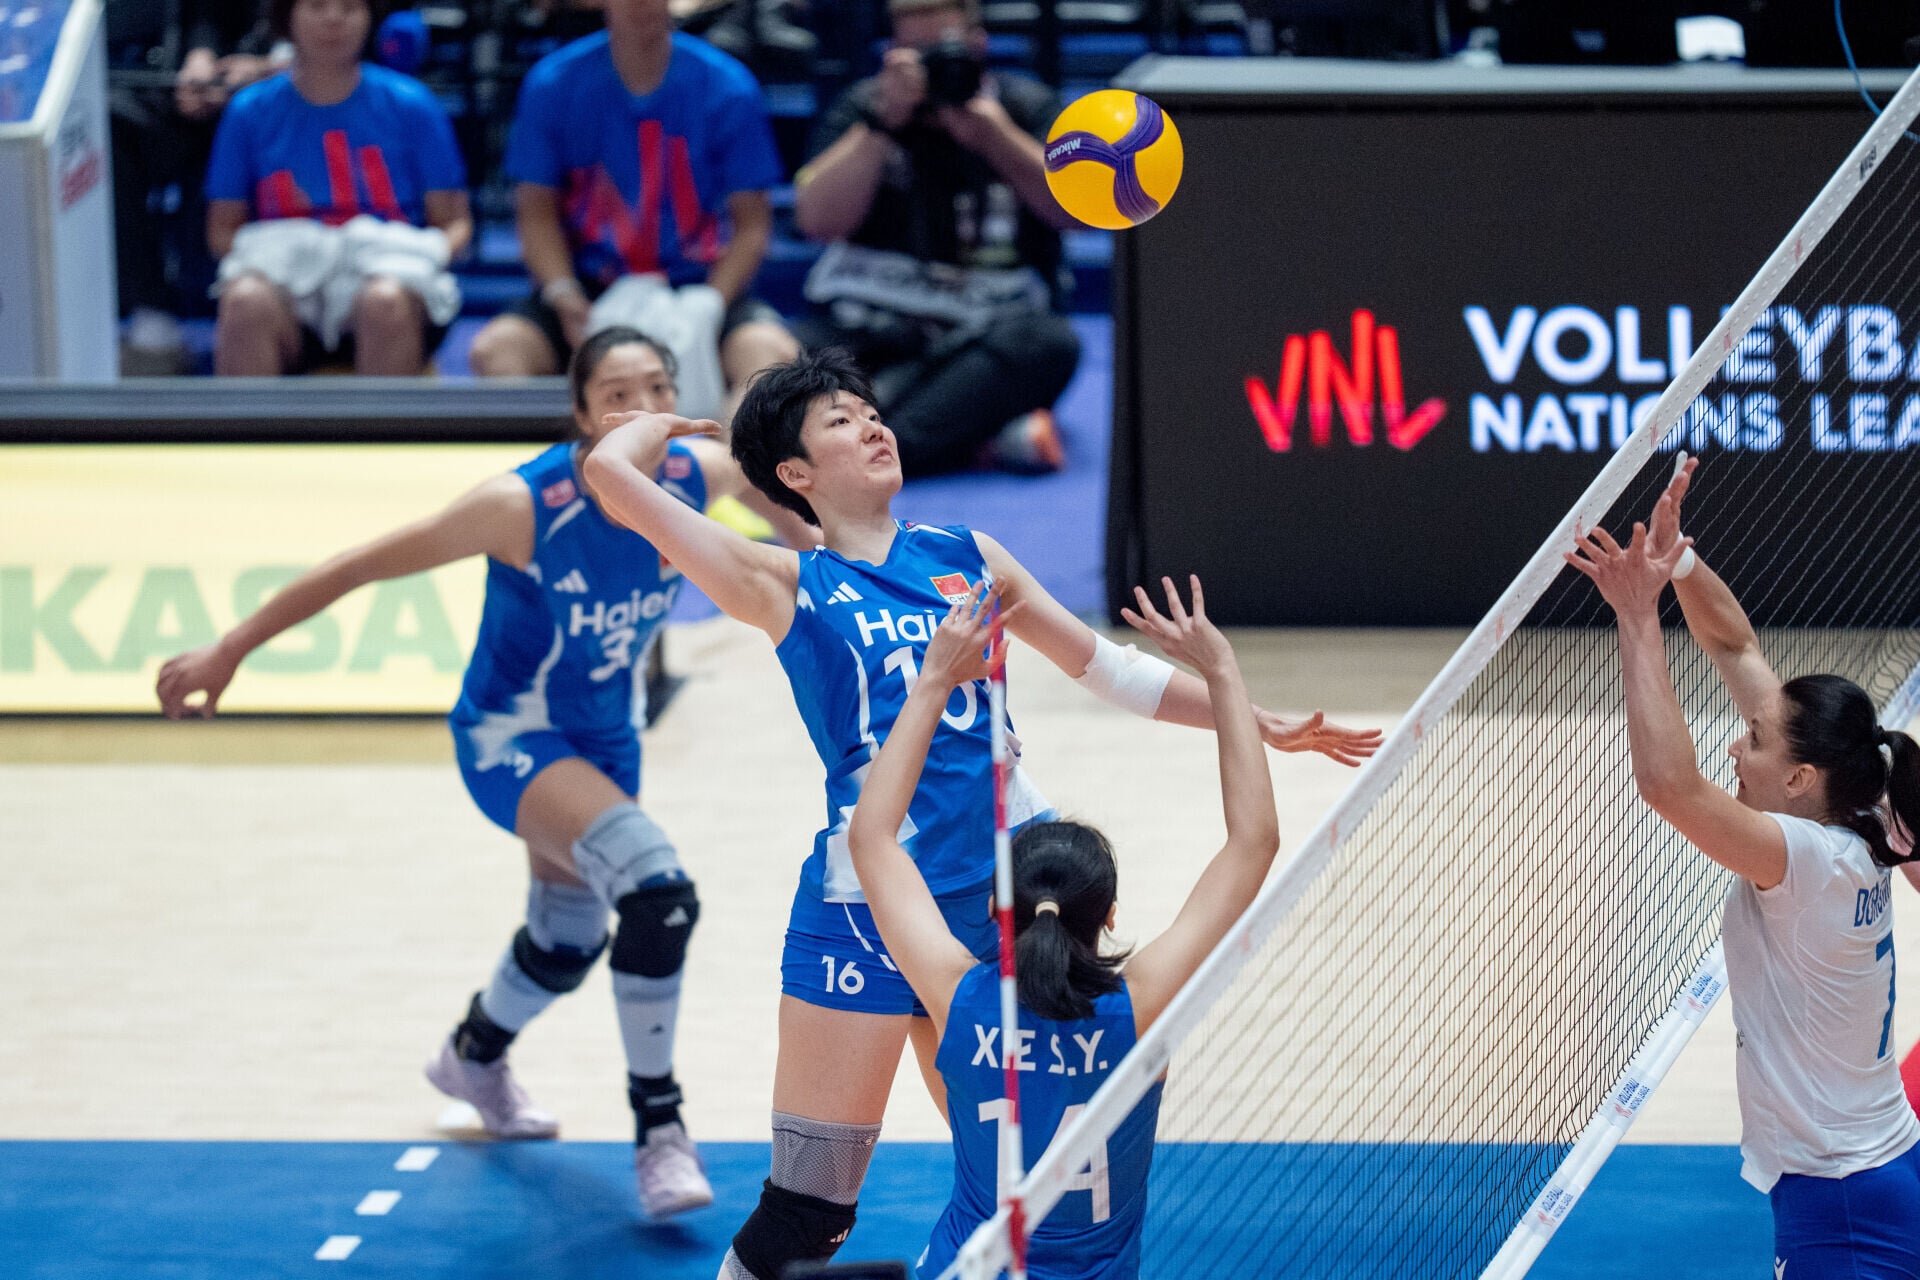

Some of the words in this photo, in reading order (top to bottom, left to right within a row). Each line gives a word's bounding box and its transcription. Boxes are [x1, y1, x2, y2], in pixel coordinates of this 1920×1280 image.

[1245, 308, 1447, 452] VNL
[1463, 304, 1920, 384] VOLLEYB
[589, 627, 637, 682] 3
[821, 955, 865, 994] 16
[1876, 929, 1896, 1060] 7
